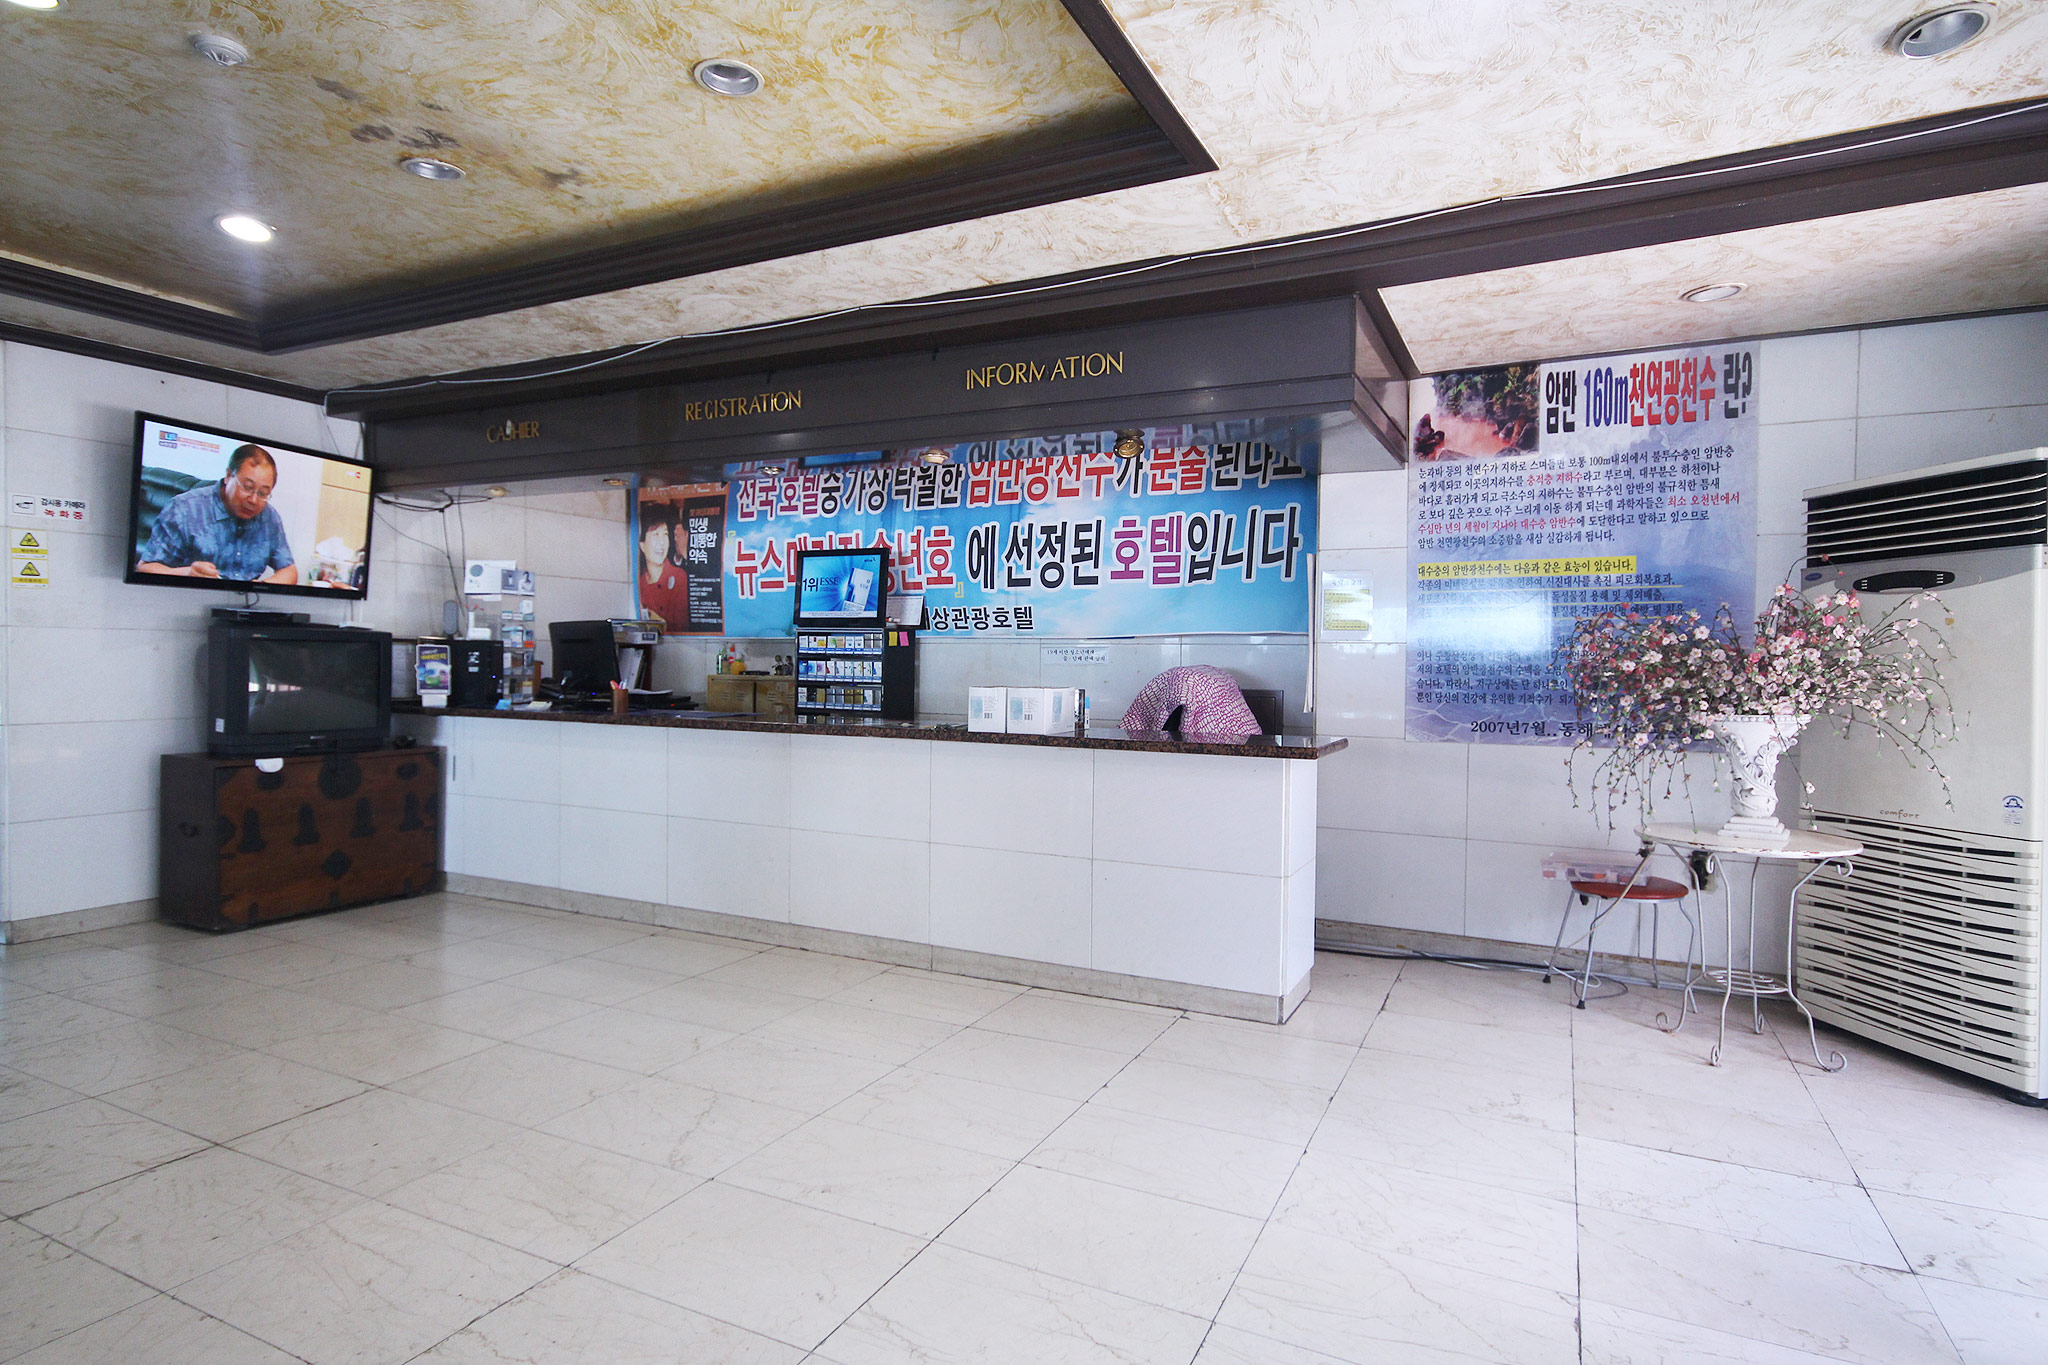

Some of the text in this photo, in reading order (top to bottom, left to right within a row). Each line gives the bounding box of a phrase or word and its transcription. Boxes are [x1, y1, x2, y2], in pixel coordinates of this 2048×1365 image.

[966, 351, 1123, 390] INFORMATION
[685, 390, 802, 421] REGISTRATION
[1545, 370, 1578, 435] 암반
[689, 518, 708, 533] 민생
[689, 532, 717, 549] 대통합
[1003, 518, 1103, 588] 선정된
[1110, 506, 1300, 585] 호텔입니다
[688, 549, 708, 564] 약속
[924, 606, 1034, 631] 상관광호텔
[1533, 679, 1568, 692] 하나인
[1879, 809, 1920, 819] comfort
